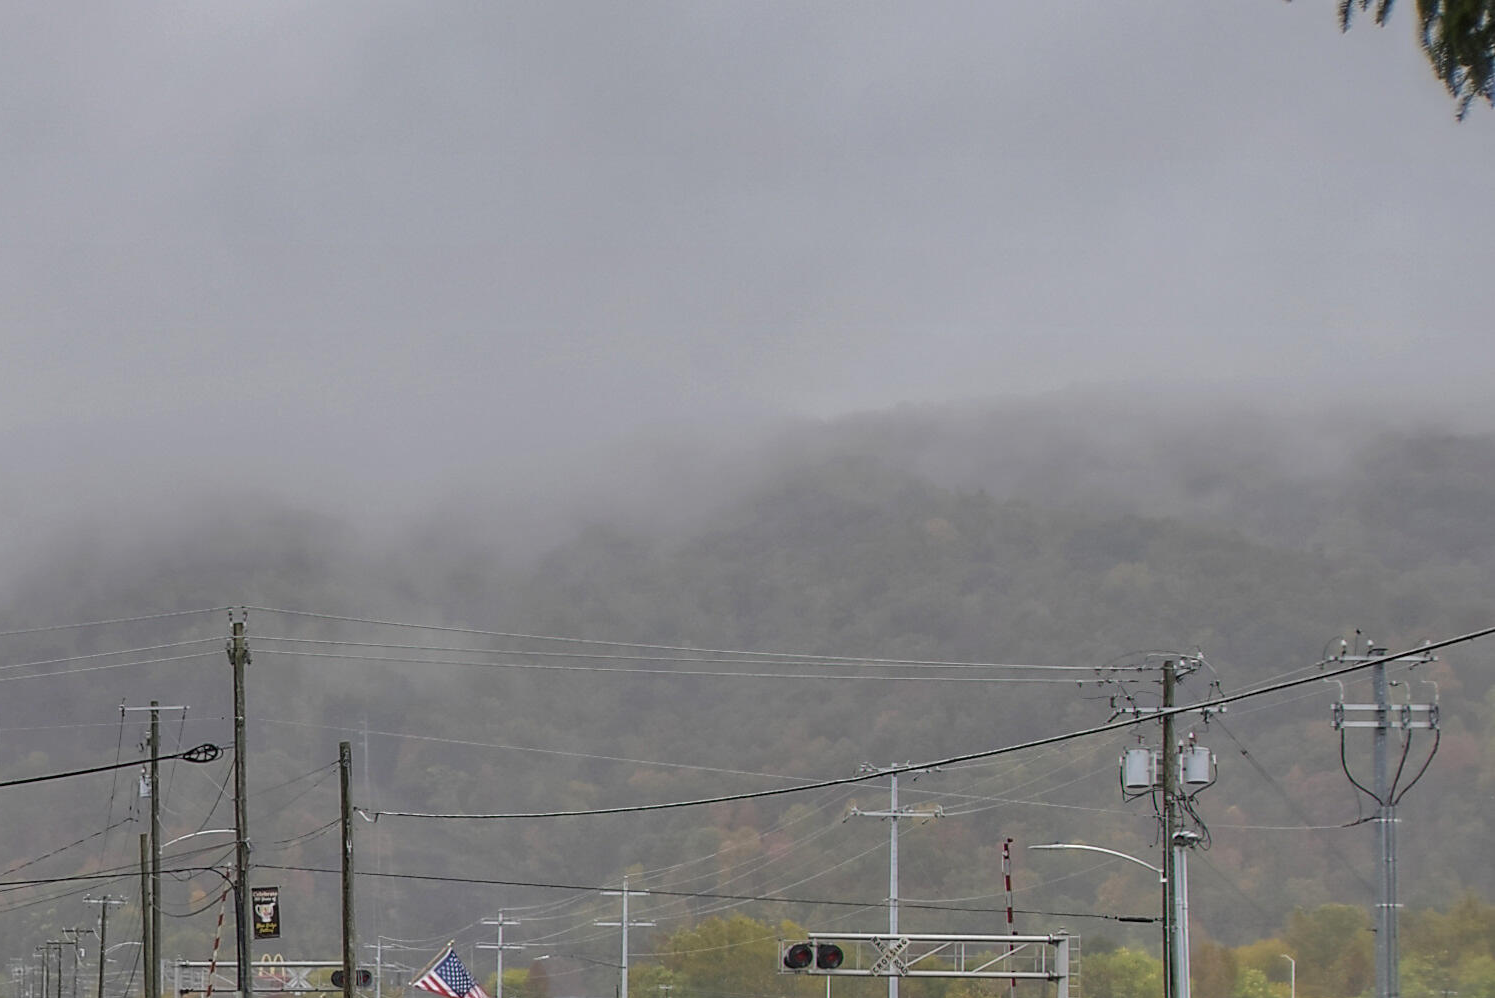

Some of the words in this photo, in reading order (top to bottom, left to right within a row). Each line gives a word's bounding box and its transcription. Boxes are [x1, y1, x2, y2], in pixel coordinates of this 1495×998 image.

[872, 937, 885, 952] RAIL
[872, 939, 907, 973] CROSSING
[893, 959, 907, 974] ROAD
